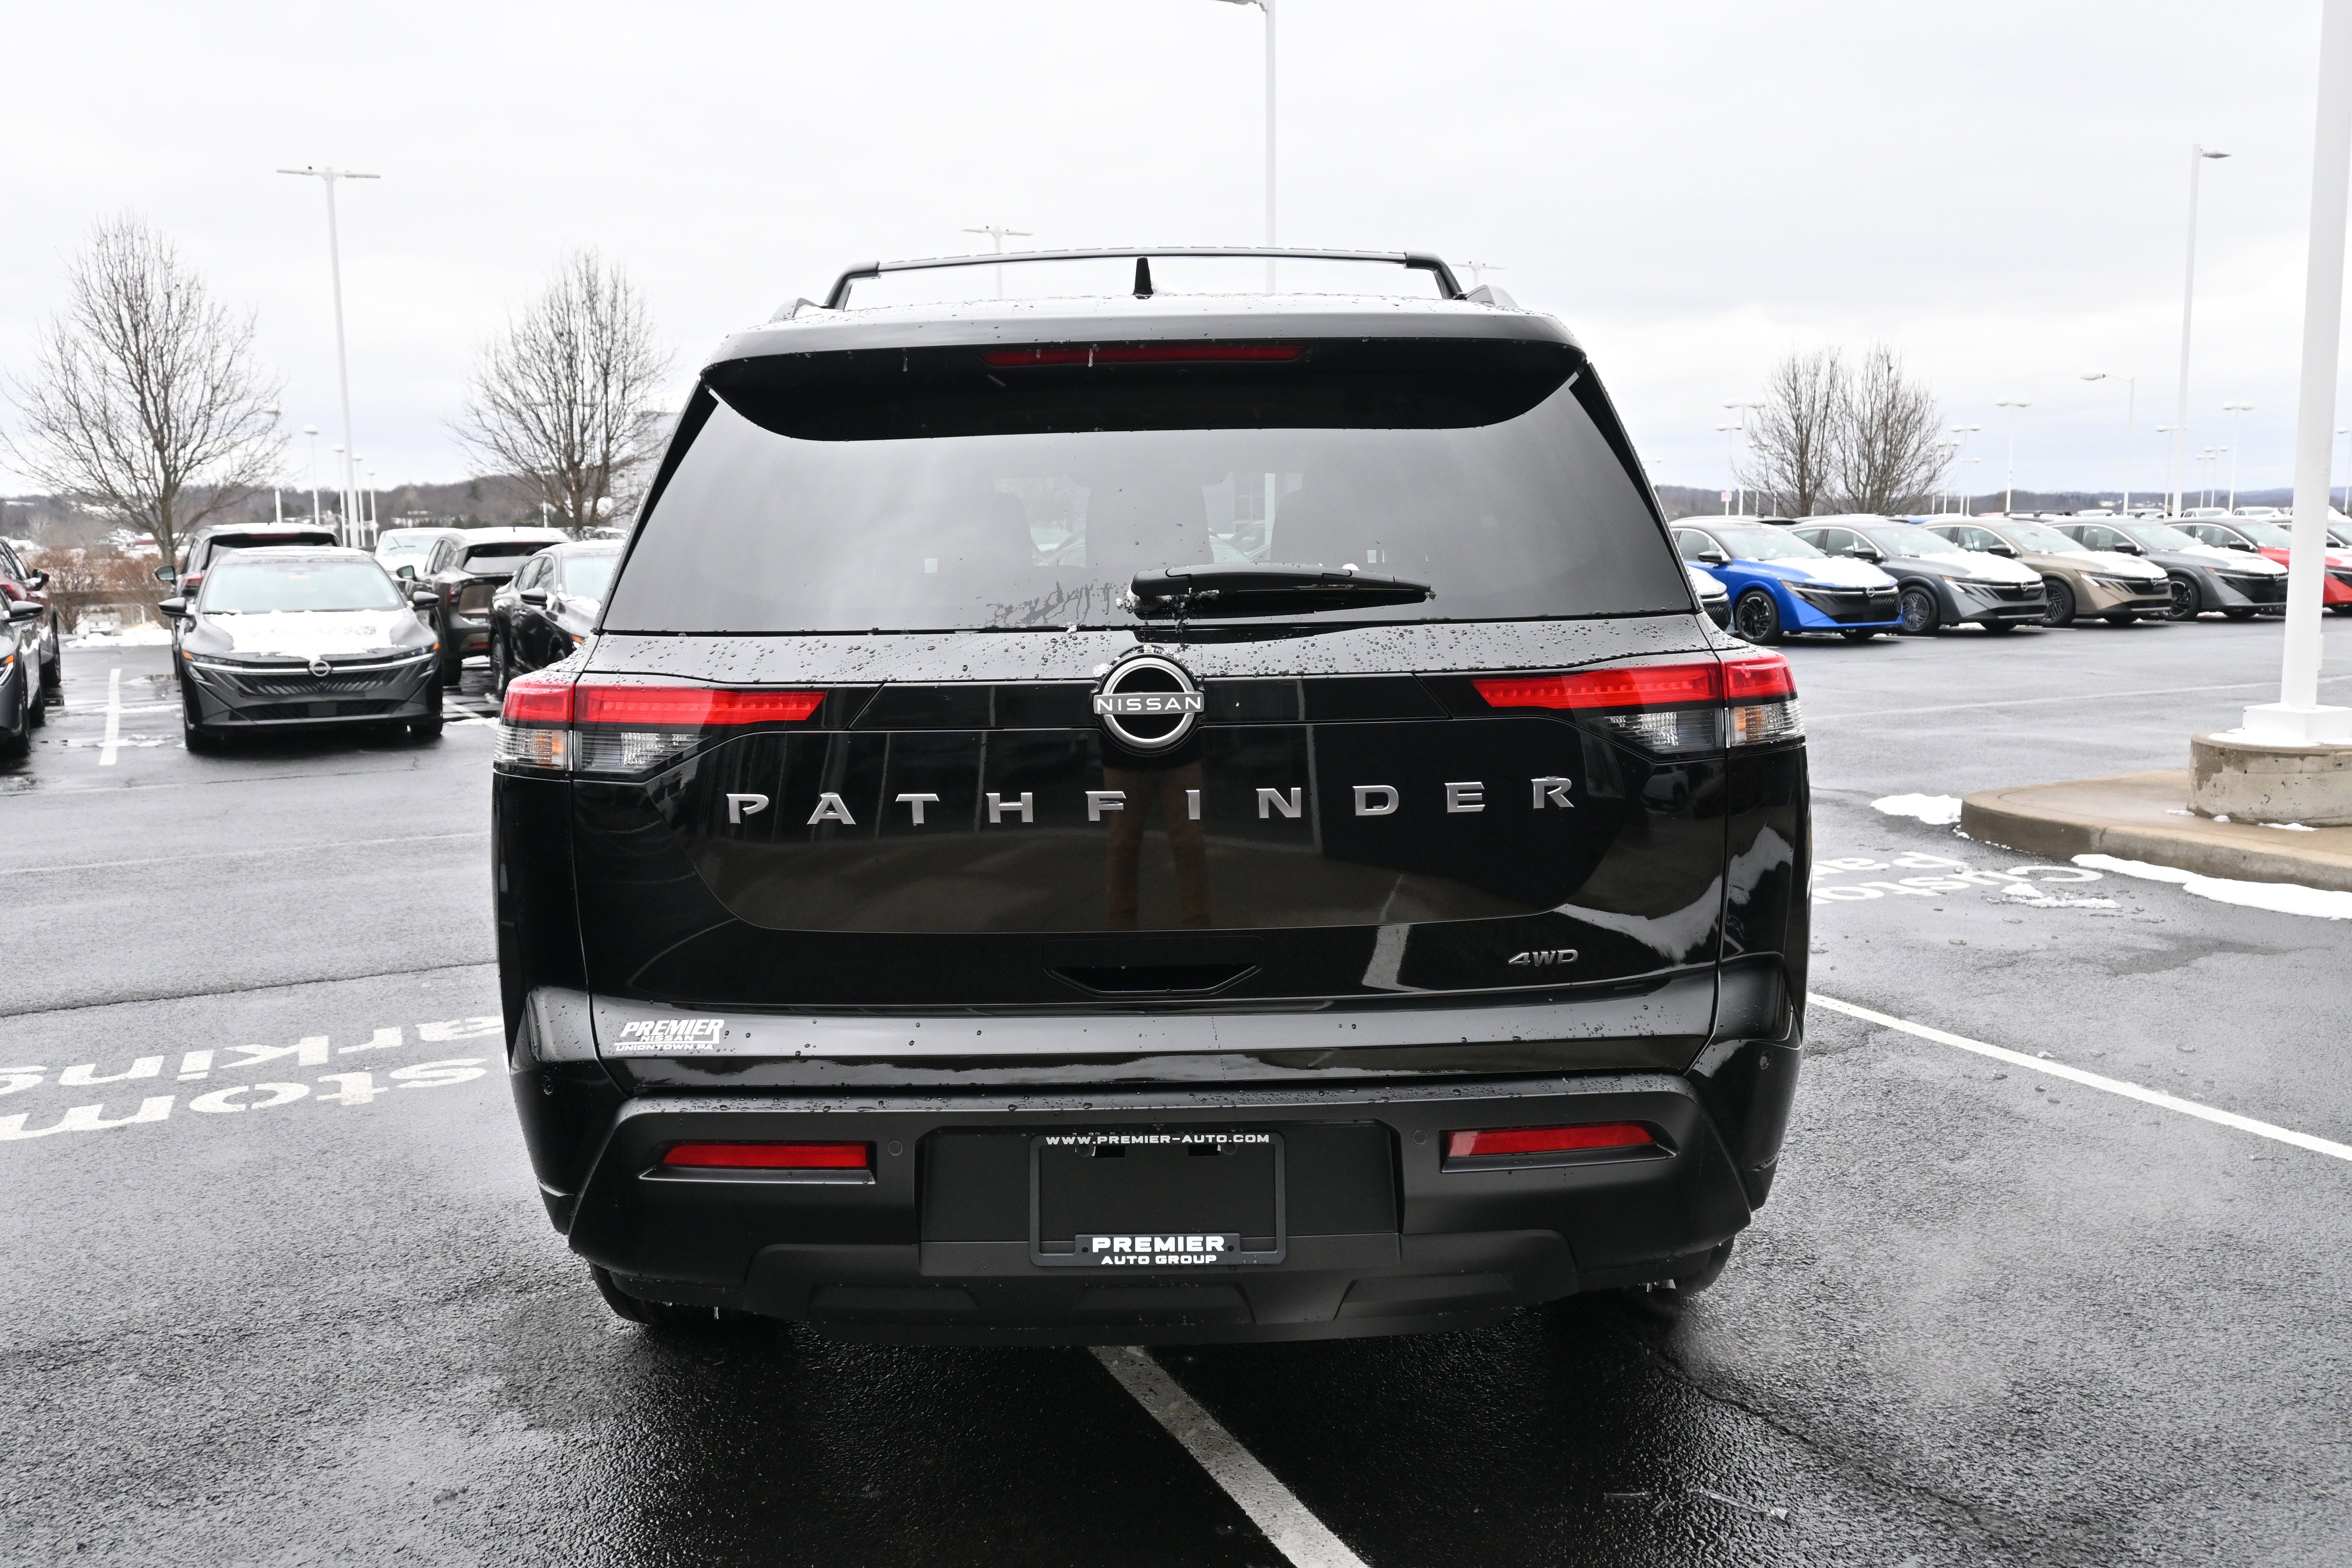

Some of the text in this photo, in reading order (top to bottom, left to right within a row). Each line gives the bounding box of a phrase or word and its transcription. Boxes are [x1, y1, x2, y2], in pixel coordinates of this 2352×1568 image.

[1097, 697, 1200, 711] NISSAN
[726, 777, 1574, 825] PATHFINDER
[1812, 866, 2103, 904] Custo
[1508, 949, 1578, 967] 4WD
[620, 1019, 724, 1037] PREMIER
[0, 1057, 510, 1140] stom
[1046, 1134, 1269, 1145] WWW.PREMIER-AUTO.COM
[1092, 1236, 1225, 1252] PREMIER
[1101, 1255, 1217, 1265] AUTO GROUP
